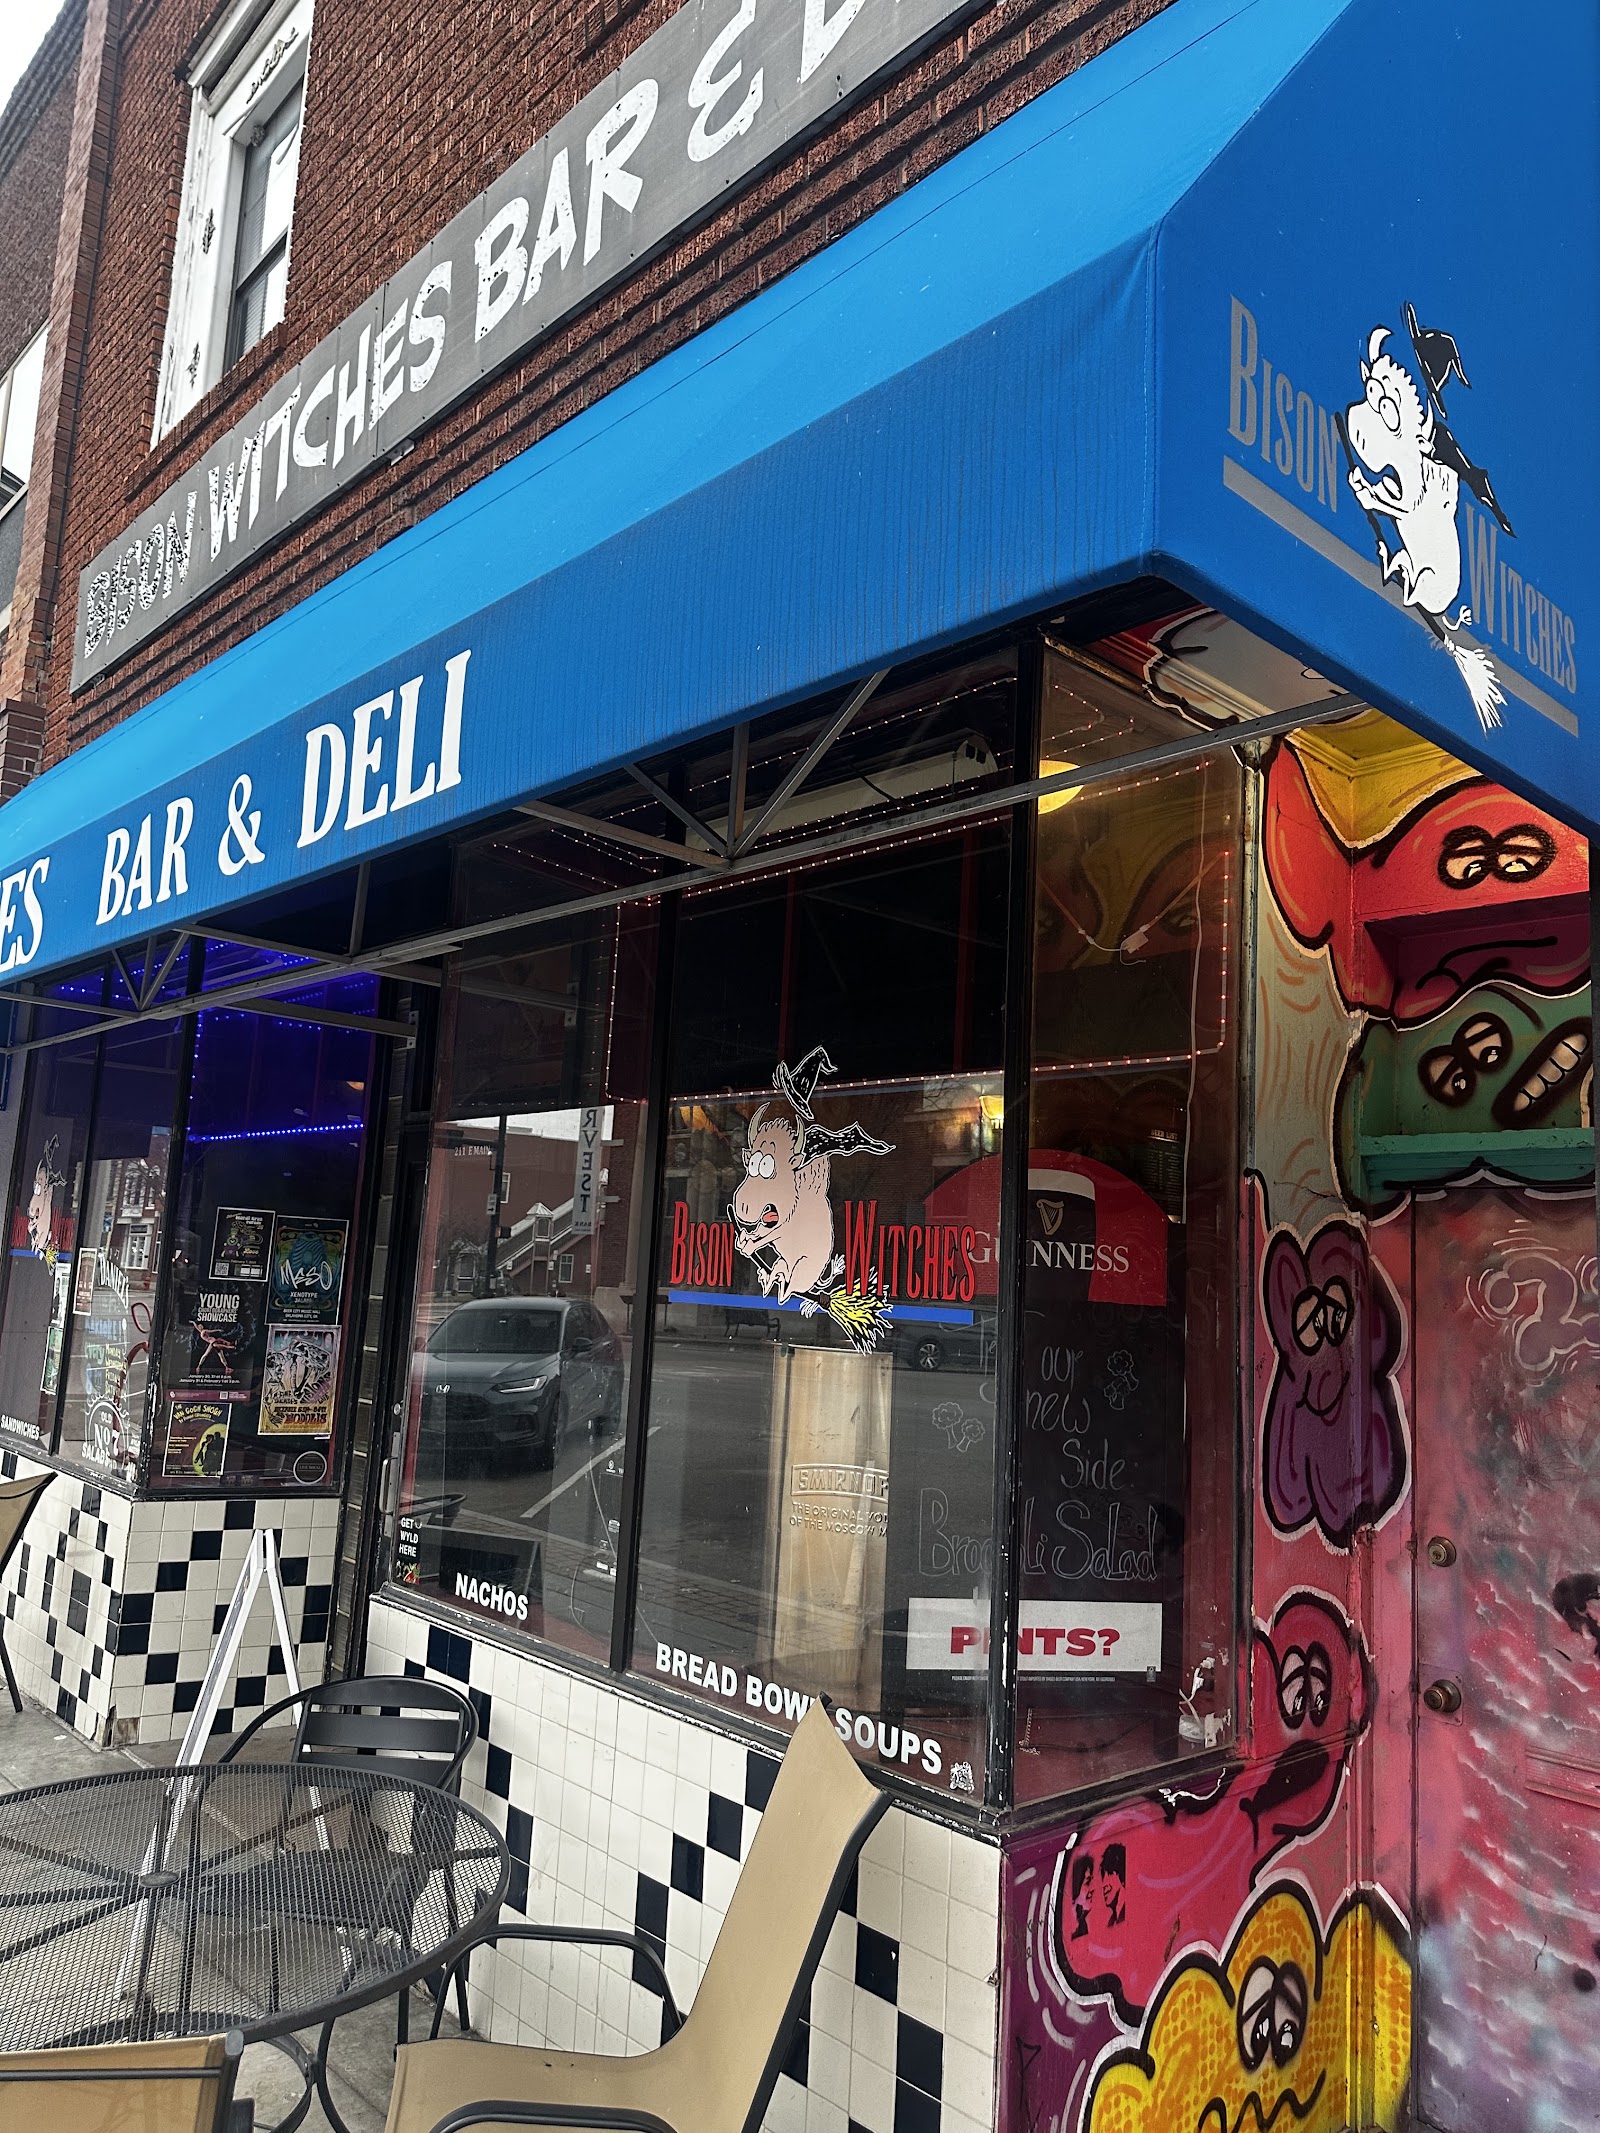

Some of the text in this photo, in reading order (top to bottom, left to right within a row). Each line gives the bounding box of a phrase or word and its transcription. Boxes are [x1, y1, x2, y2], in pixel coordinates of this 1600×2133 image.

[83, 490, 198, 660] BISON
[210, 260, 452, 562] WITCHES
[475, 78, 660, 343] BAR
[1227, 294, 1577, 694] BISON WITCHES
[96, 796, 194, 926] BAR
[217, 773, 266, 876] &
[297, 649, 472, 849] DELI
[669, 1199, 977, 1303] BISON WITCHES
[968, 1231, 1129, 1273] GNNESS
[200, 1293, 240, 1309] YOUNG
[197, 1312, 237, 1323] SHOWCASE
[1, 1414, 40, 1441] SANDWICHES
[401, 1517, 414, 1529] GET
[790, 1515, 802, 1526] OF
[804, 1517, 822, 1530] THE
[792, 1501, 810, 1515] THE
[813, 1505, 863, 1521] ORIGINAL
[399, 1543, 417, 1557] HERE
[400, 1530, 419, 1544] WYLD
[455, 1572, 529, 1621] NACHOS
[656, 1641, 738, 1697] BREAD
[835, 1707, 942, 1775] SOUPS
